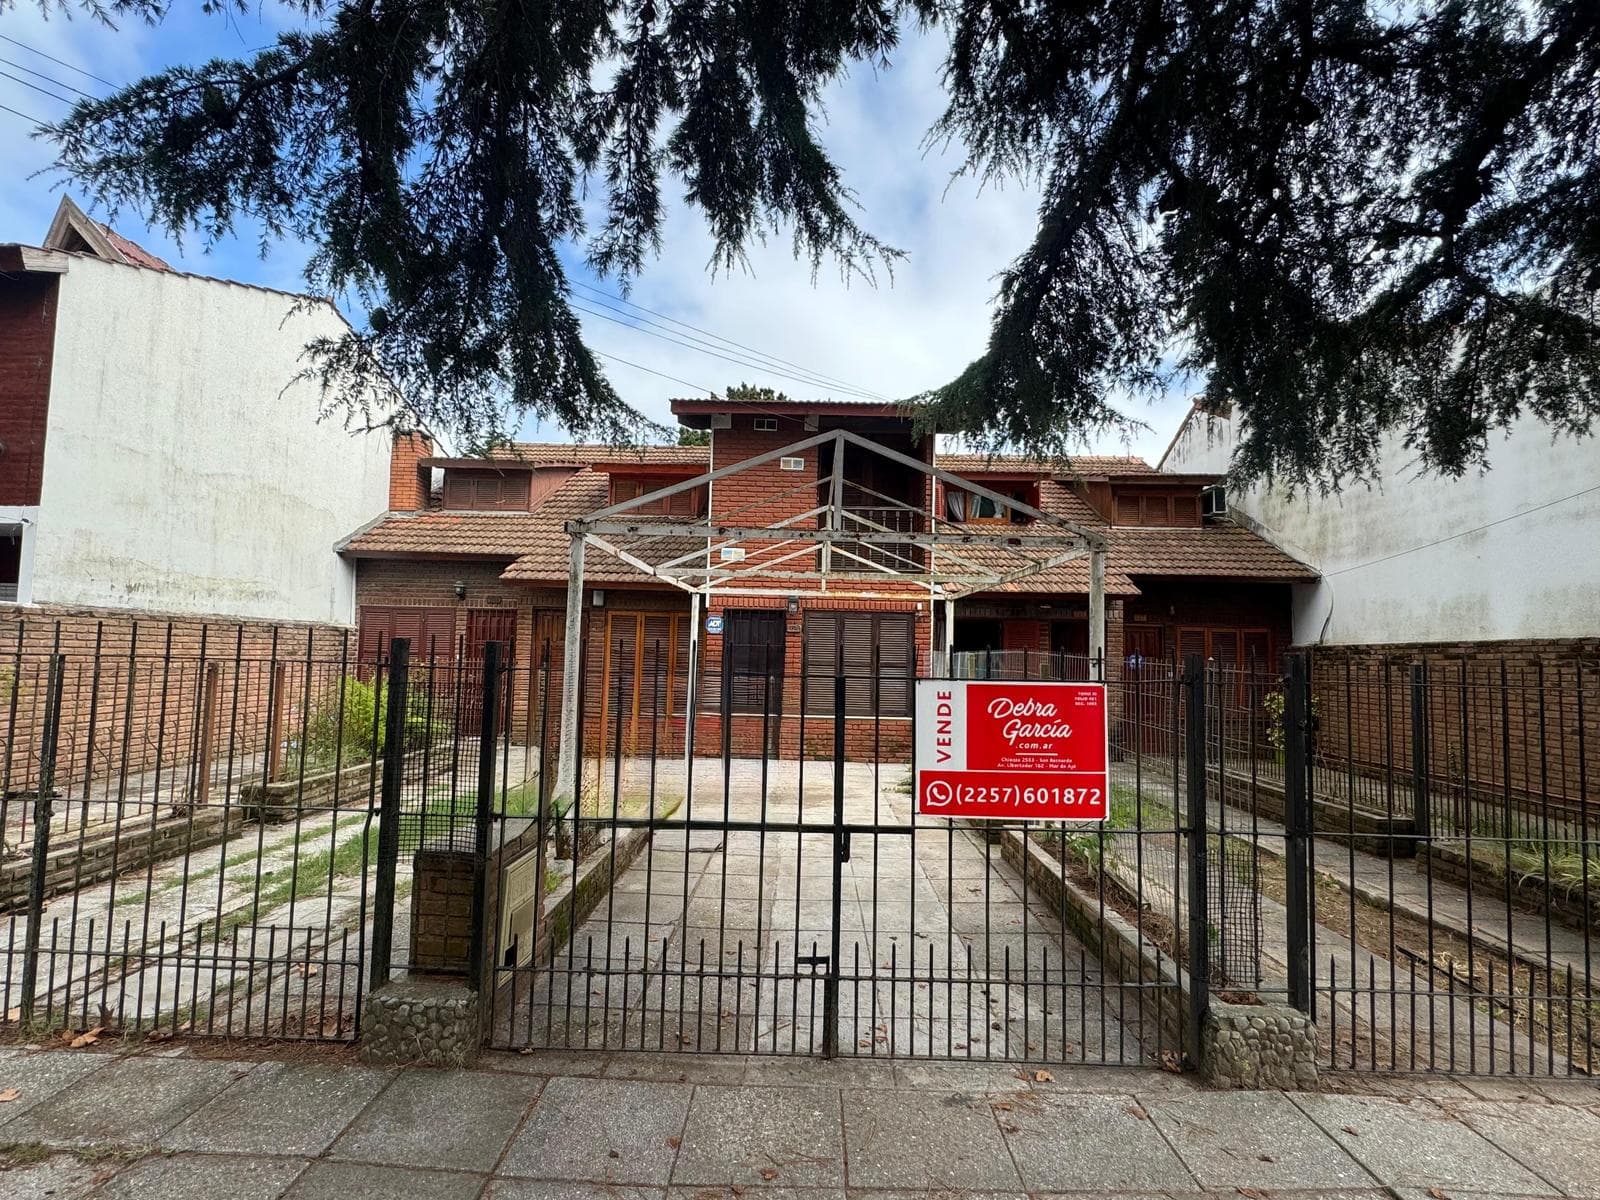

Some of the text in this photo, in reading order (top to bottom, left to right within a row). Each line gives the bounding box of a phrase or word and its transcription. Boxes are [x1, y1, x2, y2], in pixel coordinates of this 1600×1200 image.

[987, 697, 1058, 719] Debra
[937, 691, 951, 763] VENDE
[1002, 719, 1072, 746] García
[1015, 742, 1053, 750] .com.ar
[956, 784, 1101, 807] (2257)601872
